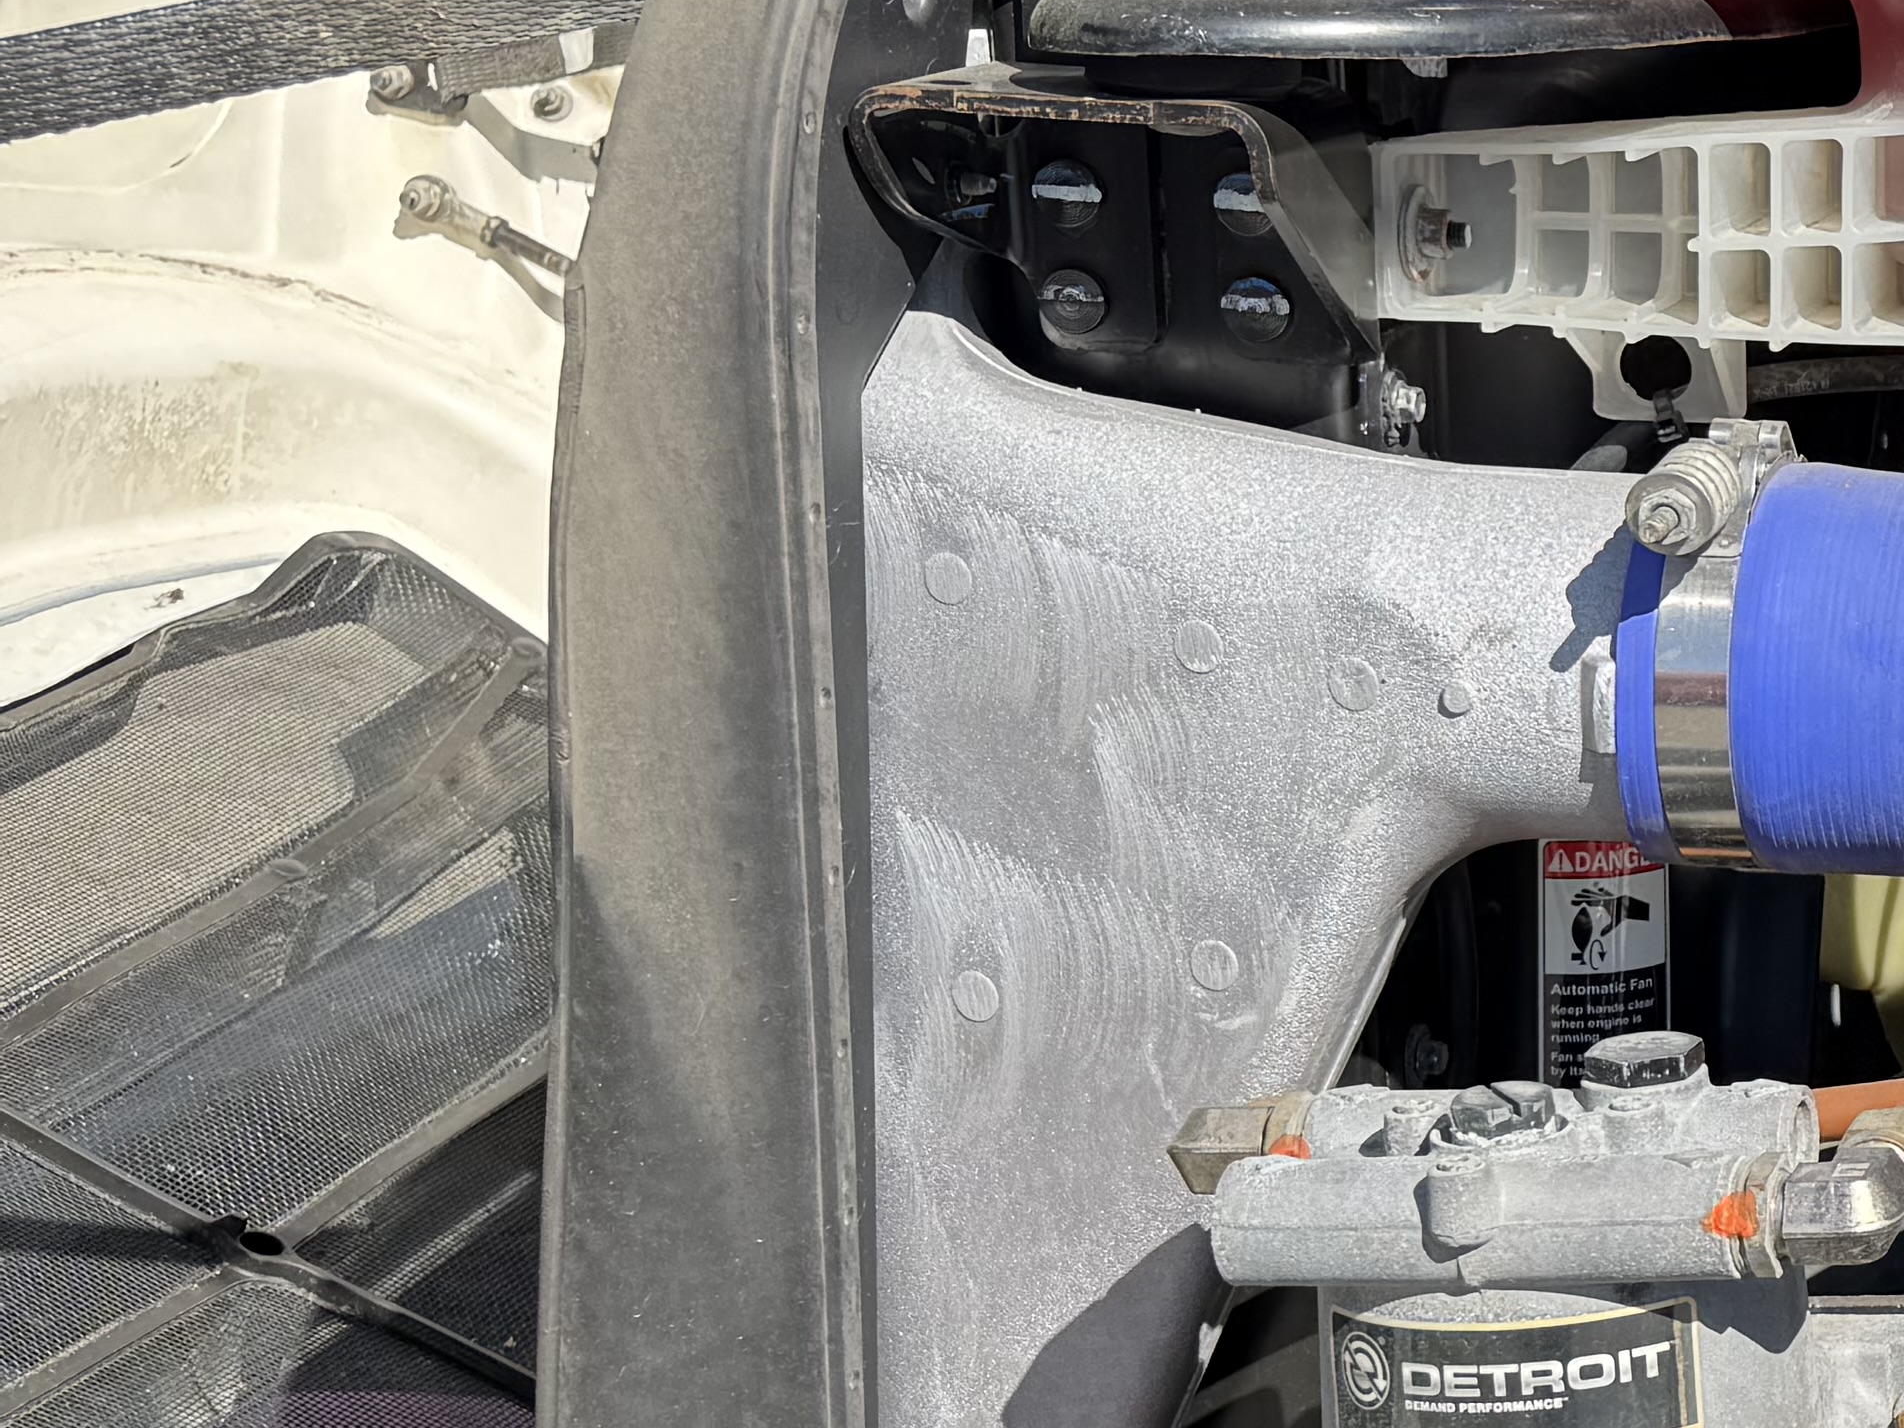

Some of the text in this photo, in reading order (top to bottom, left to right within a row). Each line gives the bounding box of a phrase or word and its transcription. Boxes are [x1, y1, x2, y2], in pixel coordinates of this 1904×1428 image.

[1550, 977, 1653, 997] Automatic Fan
[1551, 997, 1655, 1016] Keep hands clear
[1551, 1014, 1642, 1031] when engine is
[1551, 1051, 1574, 1063] Fan
[1551, 1065, 1567, 1077] by
[1402, 1341, 1671, 1399] DETROIT
[1405, 1397, 1563, 1414] DEMAND PERFORMANCE
